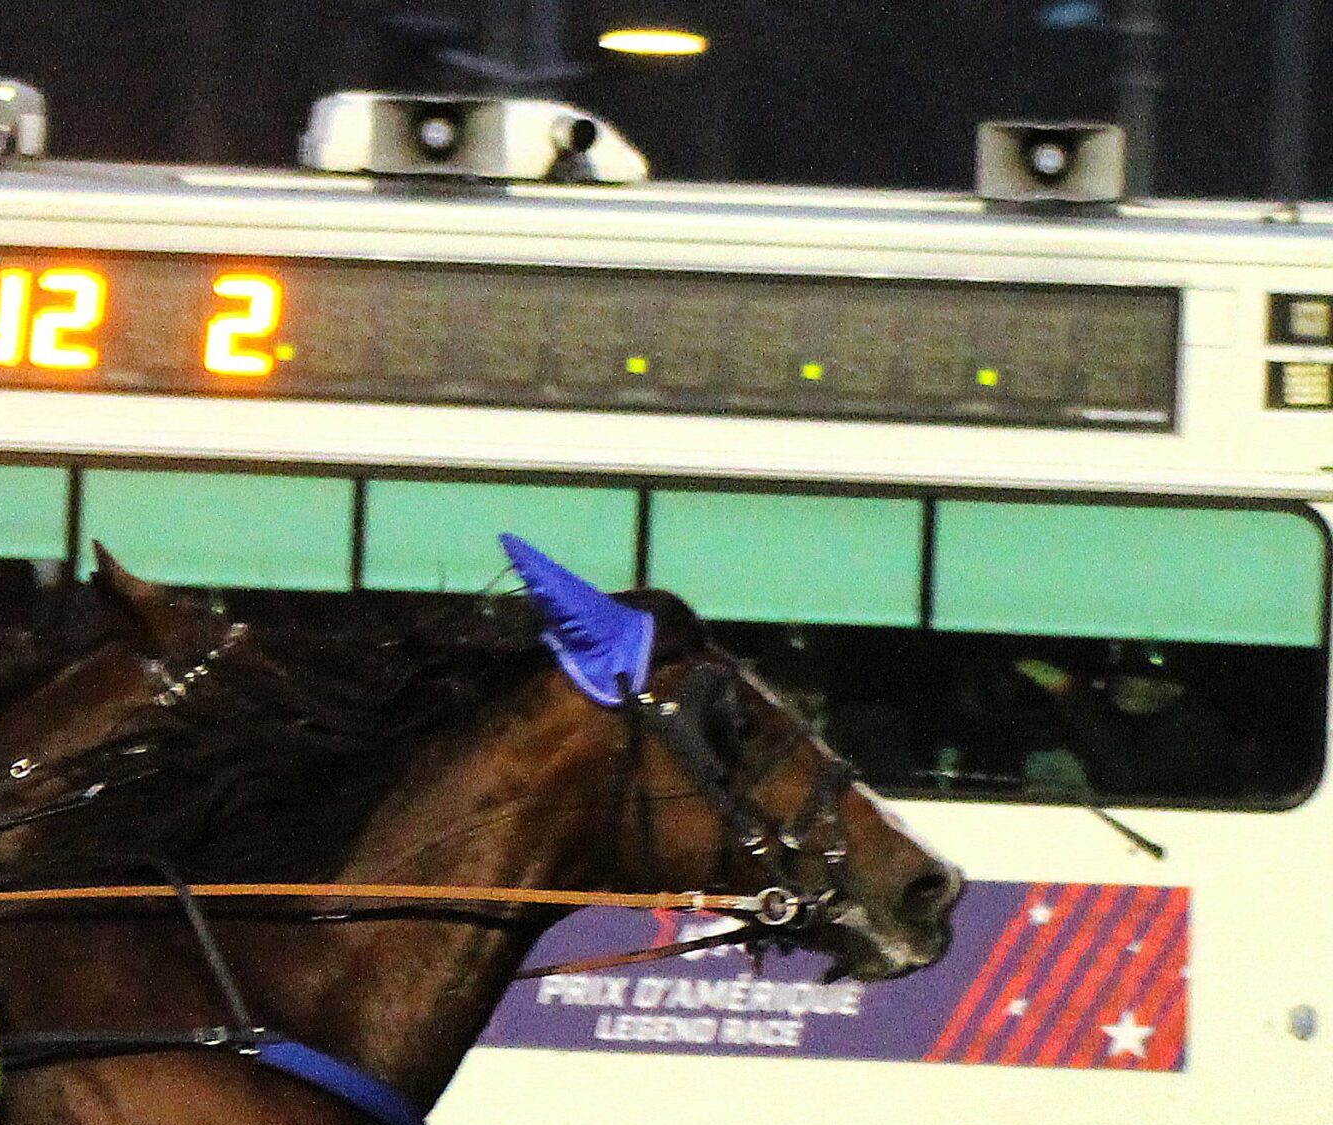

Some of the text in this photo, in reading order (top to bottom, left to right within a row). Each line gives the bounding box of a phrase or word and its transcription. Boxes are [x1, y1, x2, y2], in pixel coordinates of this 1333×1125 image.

[536, 972, 865, 1017] PRIX D'AMÉRIQUE
[594, 1013, 804, 1047] LEGEND RACE
